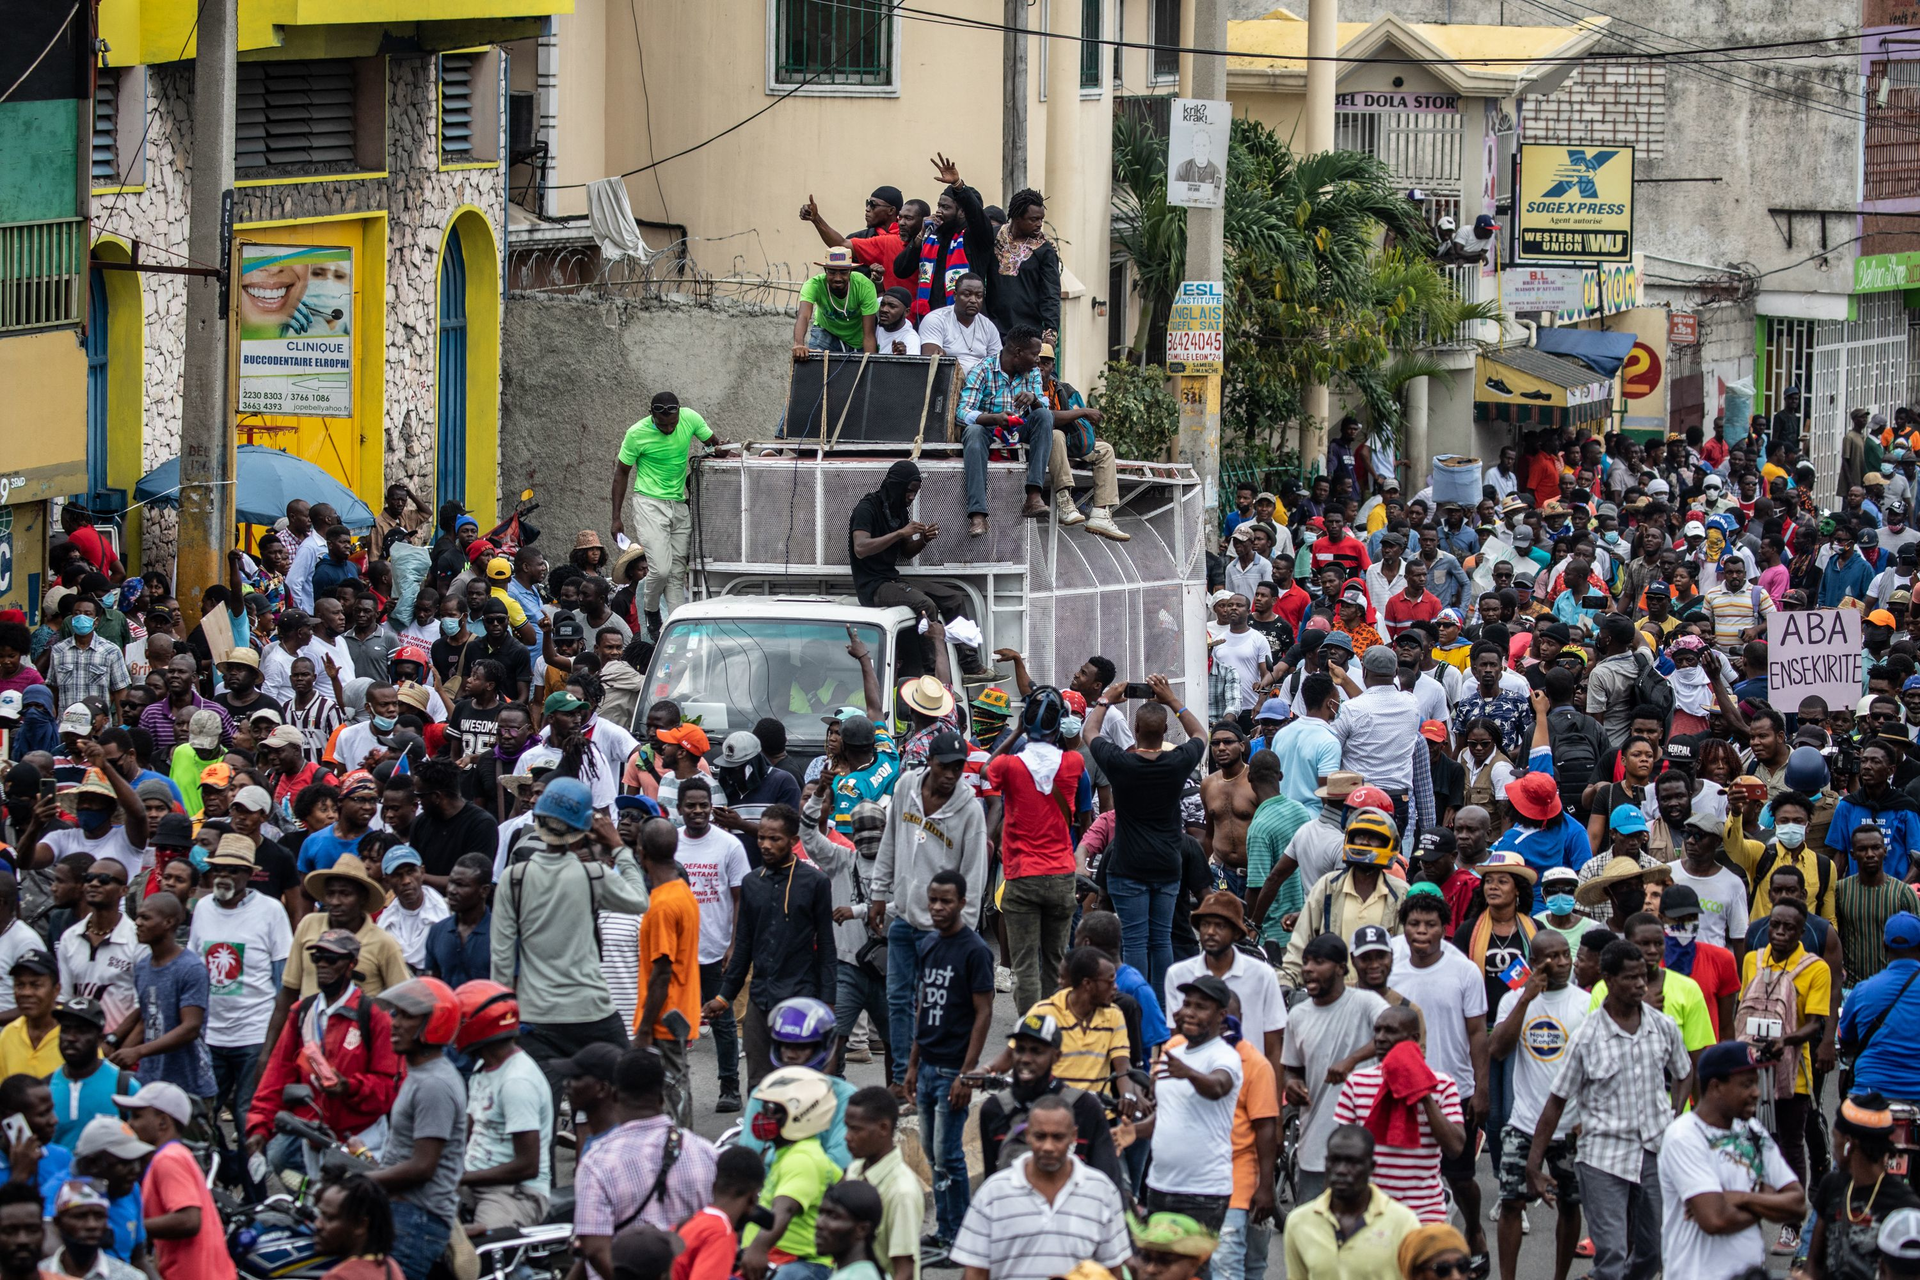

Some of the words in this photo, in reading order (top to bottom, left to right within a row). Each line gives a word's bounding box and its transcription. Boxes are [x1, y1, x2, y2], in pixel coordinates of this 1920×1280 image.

[1364, 94, 1408, 108] DOLA
[1183, 103, 1207, 115] krik?
[1182, 113, 1208, 124] krak!
[1526, 202, 1626, 215] SOGEXPRESS
[1524, 232, 1582, 242] WESTERN
[1542, 242, 1582, 252] UNION
[1588, 234, 1623, 253] WU
[1183, 284, 1222, 296] ESL
[1171, 306, 1222, 320] ANGLAIS
[1199, 321, 1221, 330] SAT
[286, 341, 344, 353] CLINIQUE
[1168, 332, 1222, 351] 36424045
[243, 355, 313, 367] BUCCODENTAIRE
[1191, 353, 1209, 361] LEON
[1623, 347, 1651, 393] 2
[243, 391, 262, 399] 2230
[263, 392, 283, 400] 8303
[290, 393, 309, 401] 3766
[312, 394, 330, 402] 1086
[242, 401, 261, 410] 3663
[263, 402, 283, 410] 4393
[1780, 611, 1848, 646] ABA
[1769, 654, 1862, 690] ENSEKIRITE
[546, 791, 581, 814] PRESS
[1365, 928, 1377, 942] E
[925, 987, 947, 1005] DO
